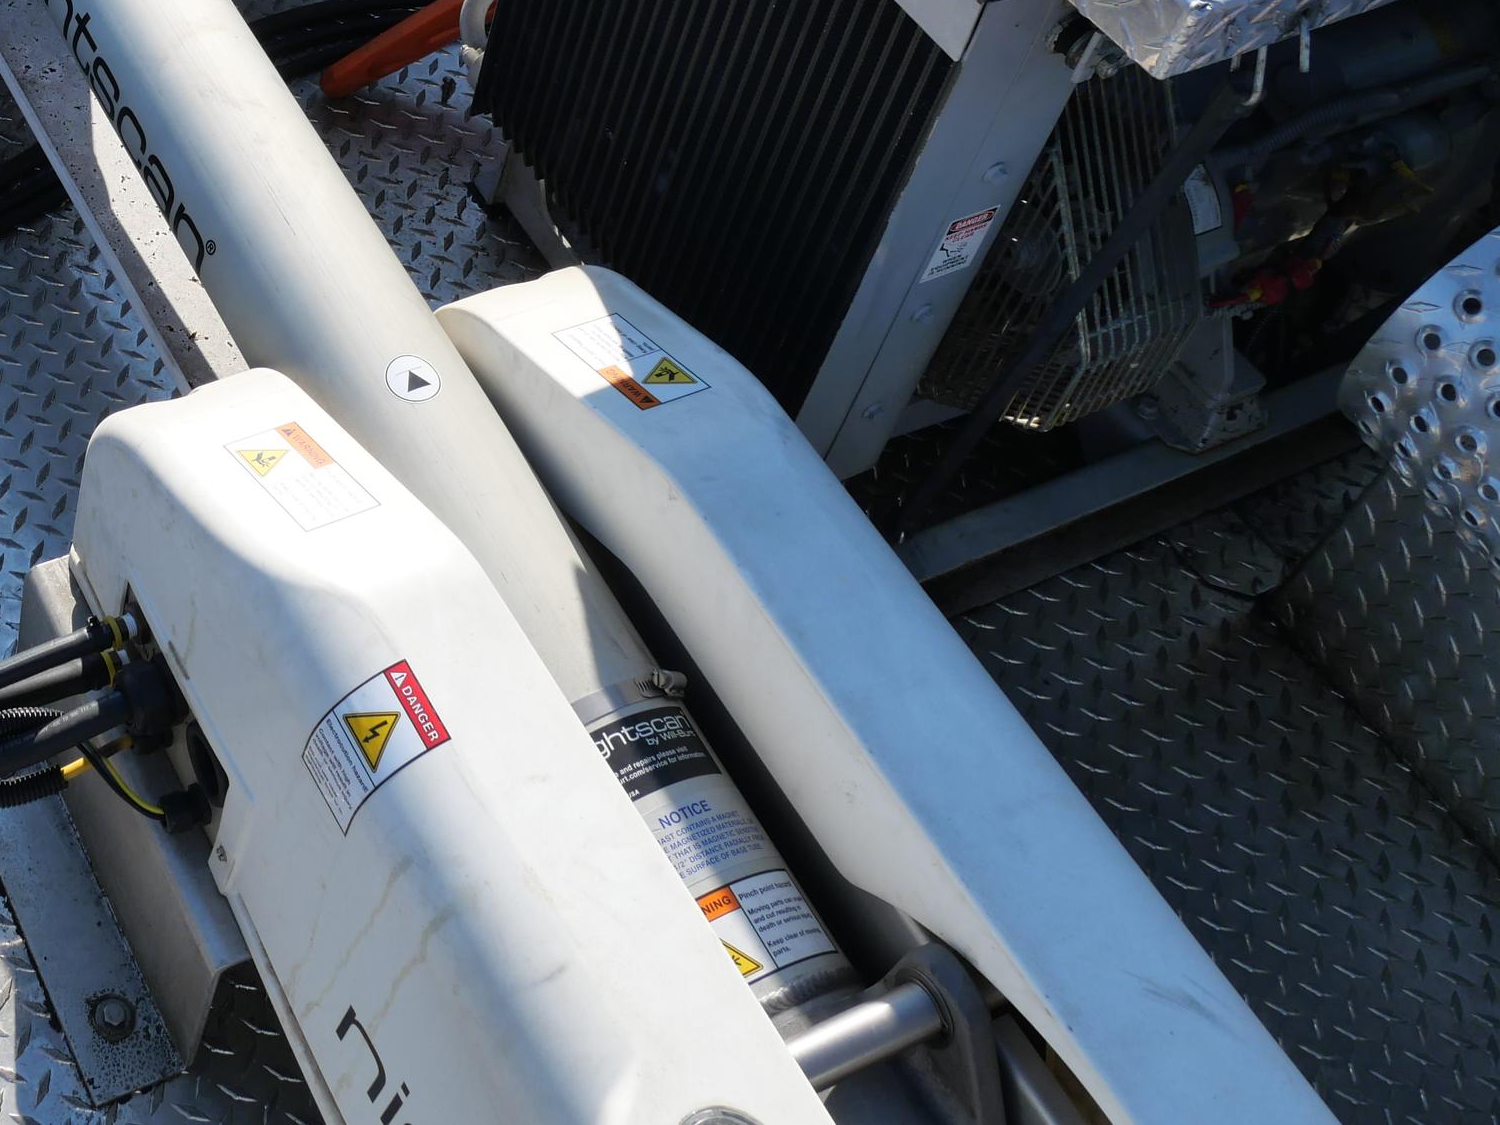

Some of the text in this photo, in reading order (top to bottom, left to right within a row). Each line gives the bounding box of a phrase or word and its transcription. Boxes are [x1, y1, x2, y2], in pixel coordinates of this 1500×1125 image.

[401, 685, 439, 742] DANGER
[324, 718, 355, 766] Electrocution
[646, 737, 659, 746] by
[619, 764, 633, 775] and
[633, 755, 656, 769] repairs
[656, 749, 676, 760] please
[658, 800, 712, 829] NOTICE
[686, 857, 721, 876] SURFACE
[721, 852, 730, 860] OF
[739, 888, 758, 900] Pinch
